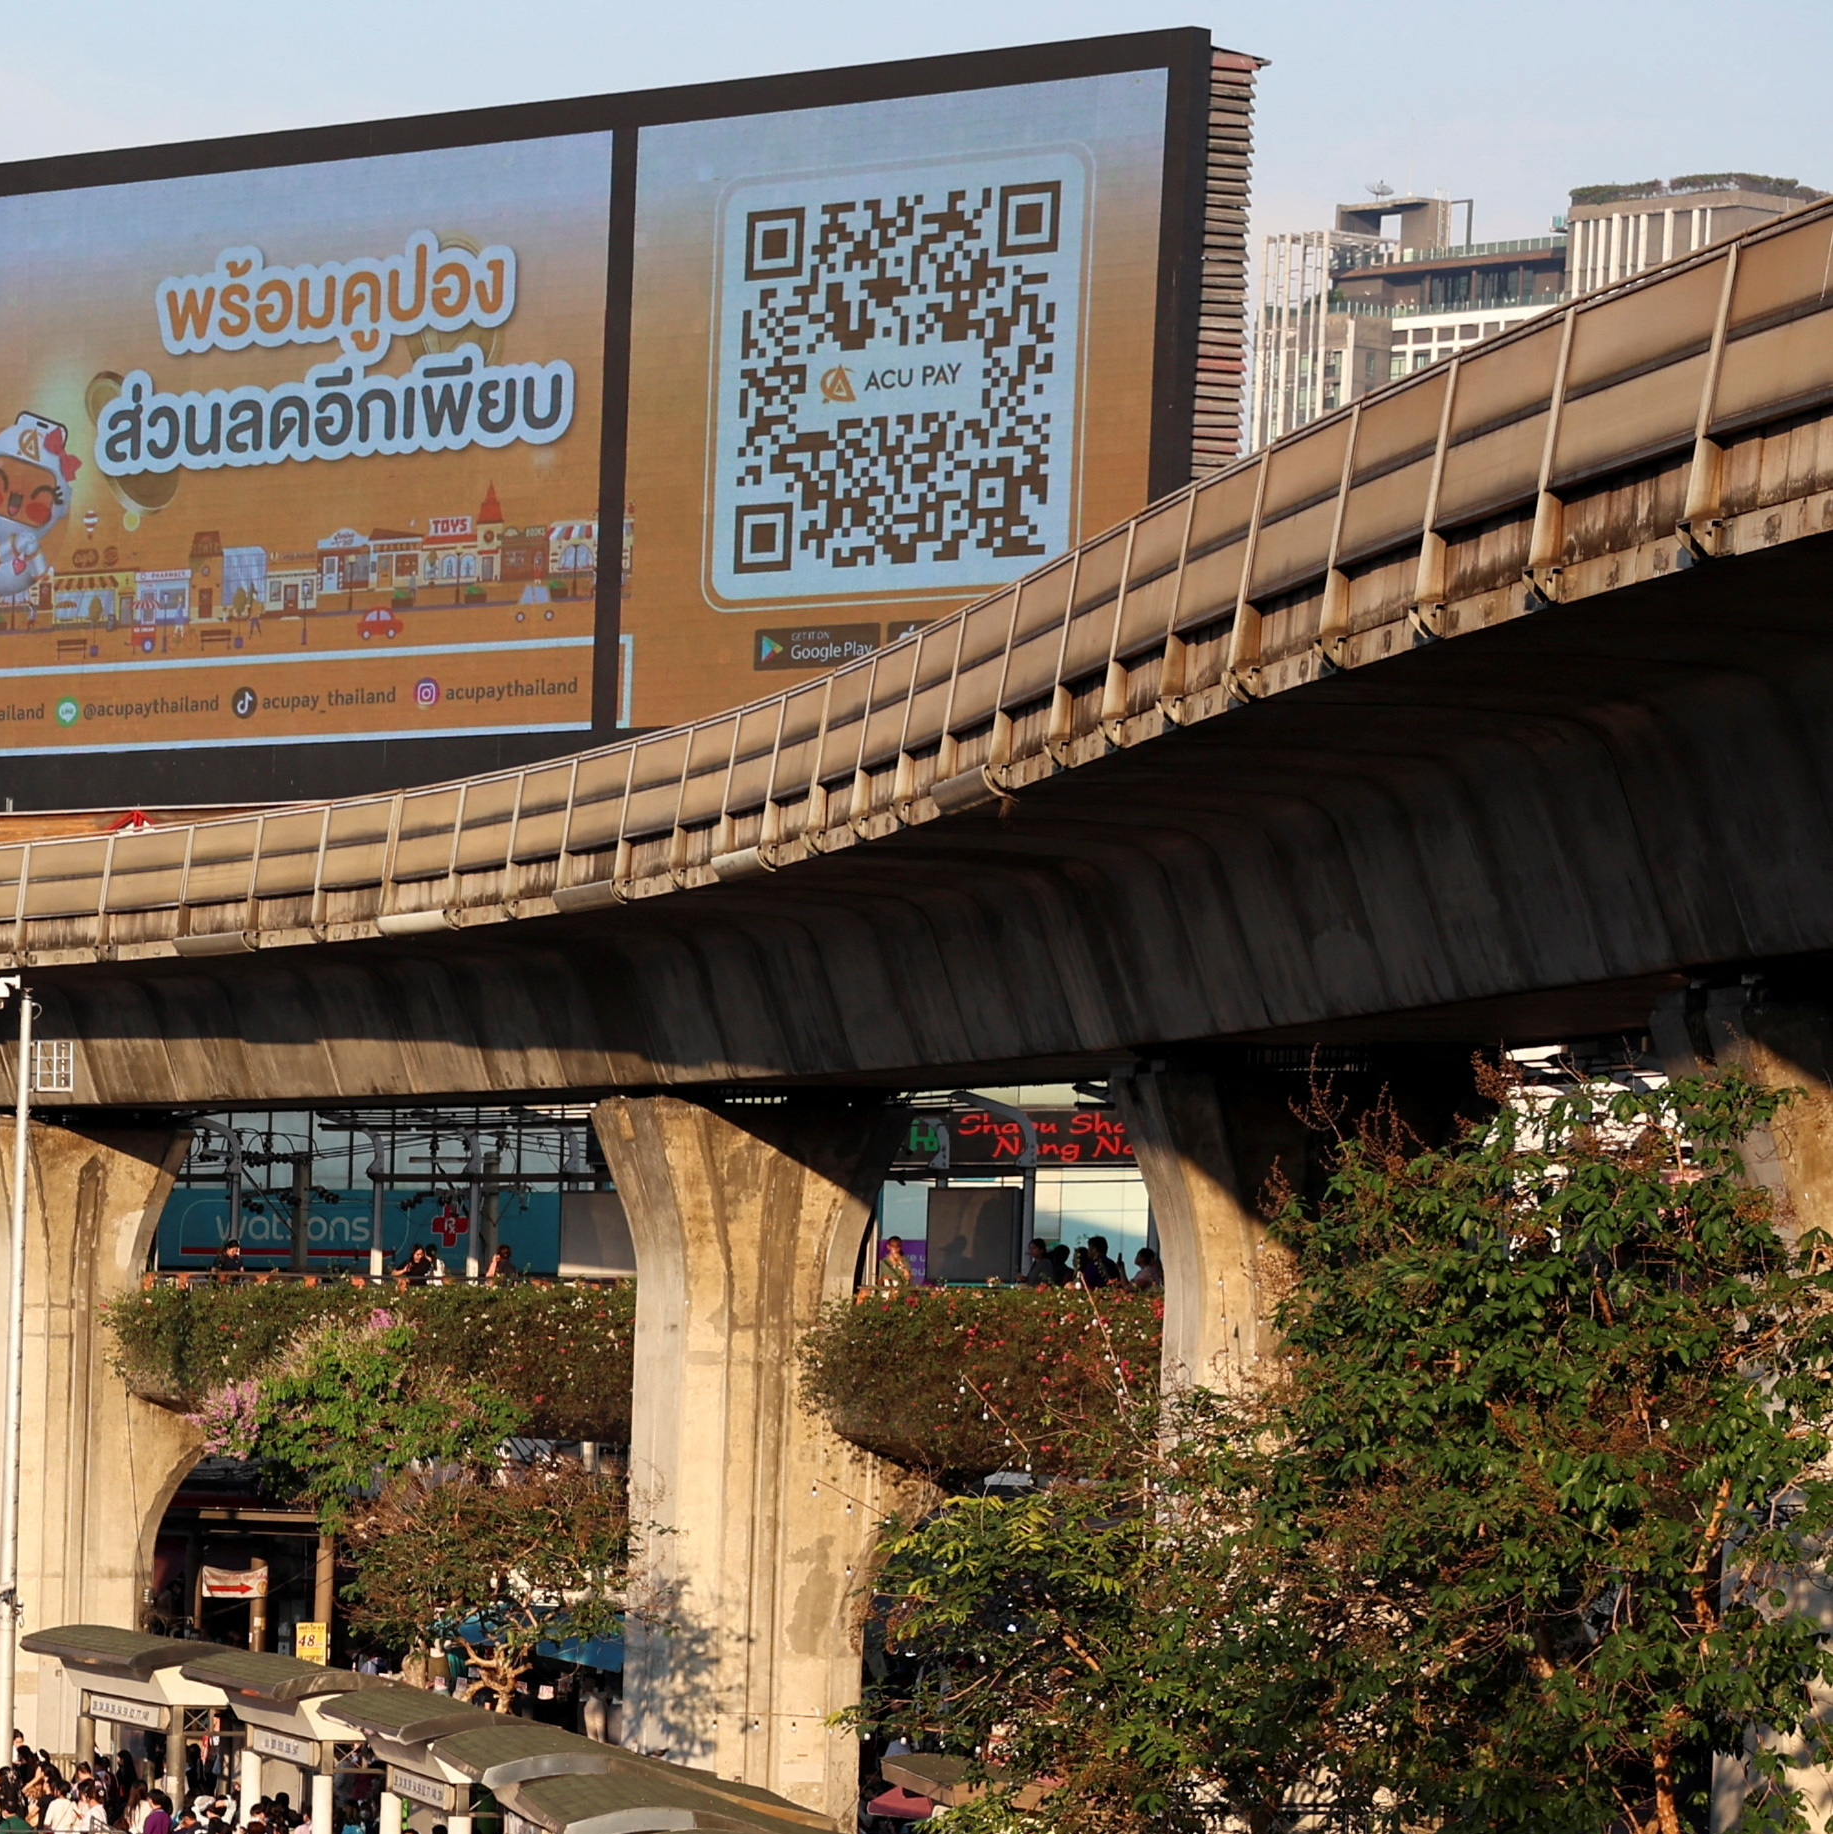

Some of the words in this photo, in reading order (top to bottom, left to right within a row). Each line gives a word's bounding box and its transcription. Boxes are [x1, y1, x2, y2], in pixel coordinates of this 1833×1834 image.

[166, 243, 504, 351] พร้อมคูปอง
[864, 367, 913, 391] ACU
[922, 363, 962, 386] PAY
[105, 356, 563, 463] ส่วนลดอีกเพียบ
[432, 518, 468, 533] TOYS
[791, 643, 841, 661] Google
[83, 695, 219, 720] @acupaythailand
[263, 686, 396, 713] acupay_thailand
[446, 677, 578, 703] acupaythailand
[216, 1214, 370, 1242] watons
[298, 1634, 315, 1647] 48
